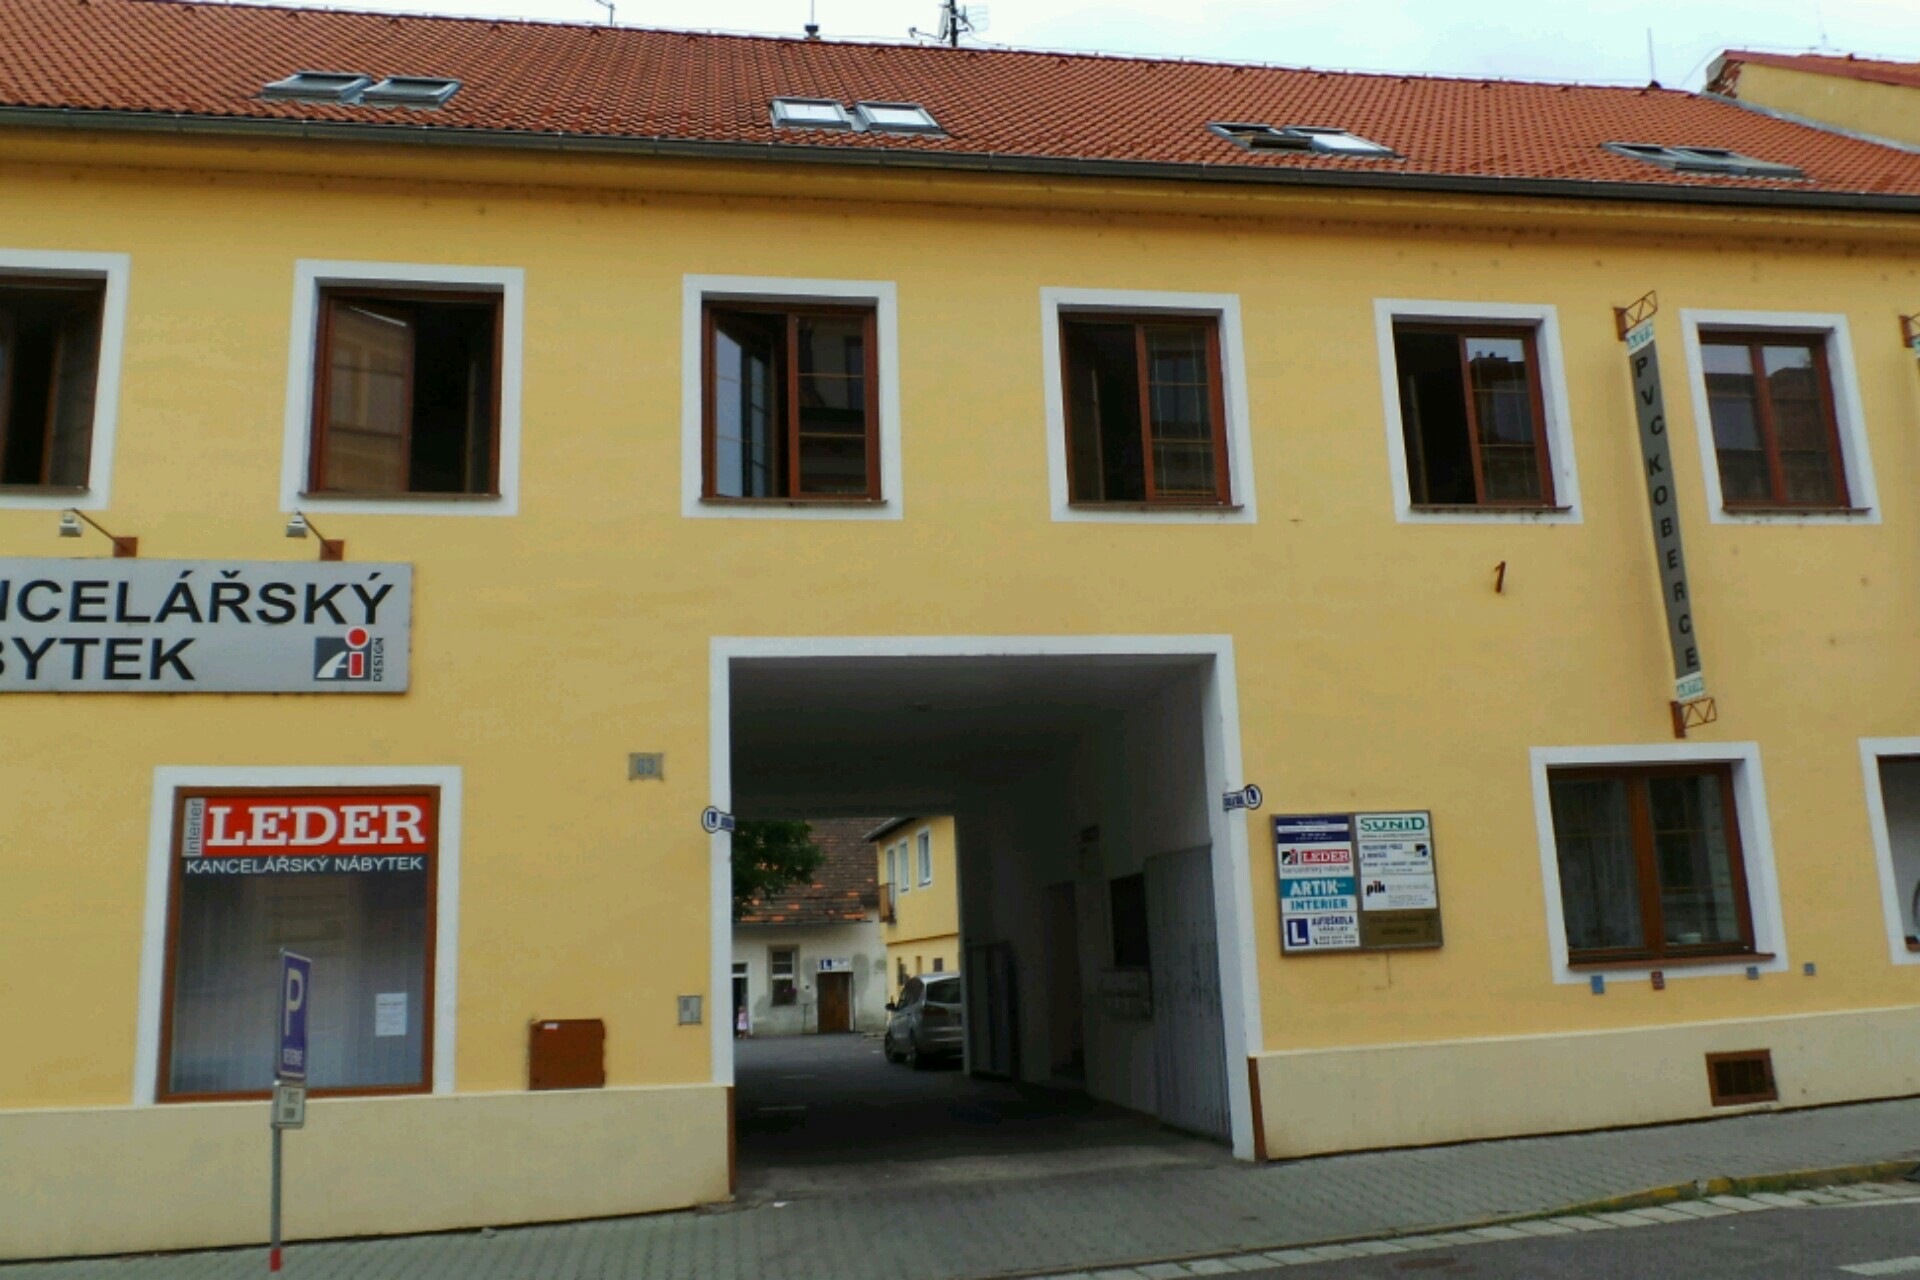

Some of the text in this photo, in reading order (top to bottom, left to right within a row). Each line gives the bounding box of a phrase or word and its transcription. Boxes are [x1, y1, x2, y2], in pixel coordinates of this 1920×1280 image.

[1635, 356, 1664, 435] PVC
[1647, 455, 1698, 668] KOBERCE
[0, 637, 196, 681] YTEK
[373, 637, 384, 682] DESIGN
[189, 802, 202, 856] interier
[207, 805, 425, 846] LEDER
[186, 855, 422, 874] KANCELÁŘSKÝ NÁBYTEK
[1302, 850, 1349, 863] LEDER
[1291, 899, 1348, 911] INTERIER
[1290, 921, 1306, 944] L
[284, 968, 303, 1037] P
